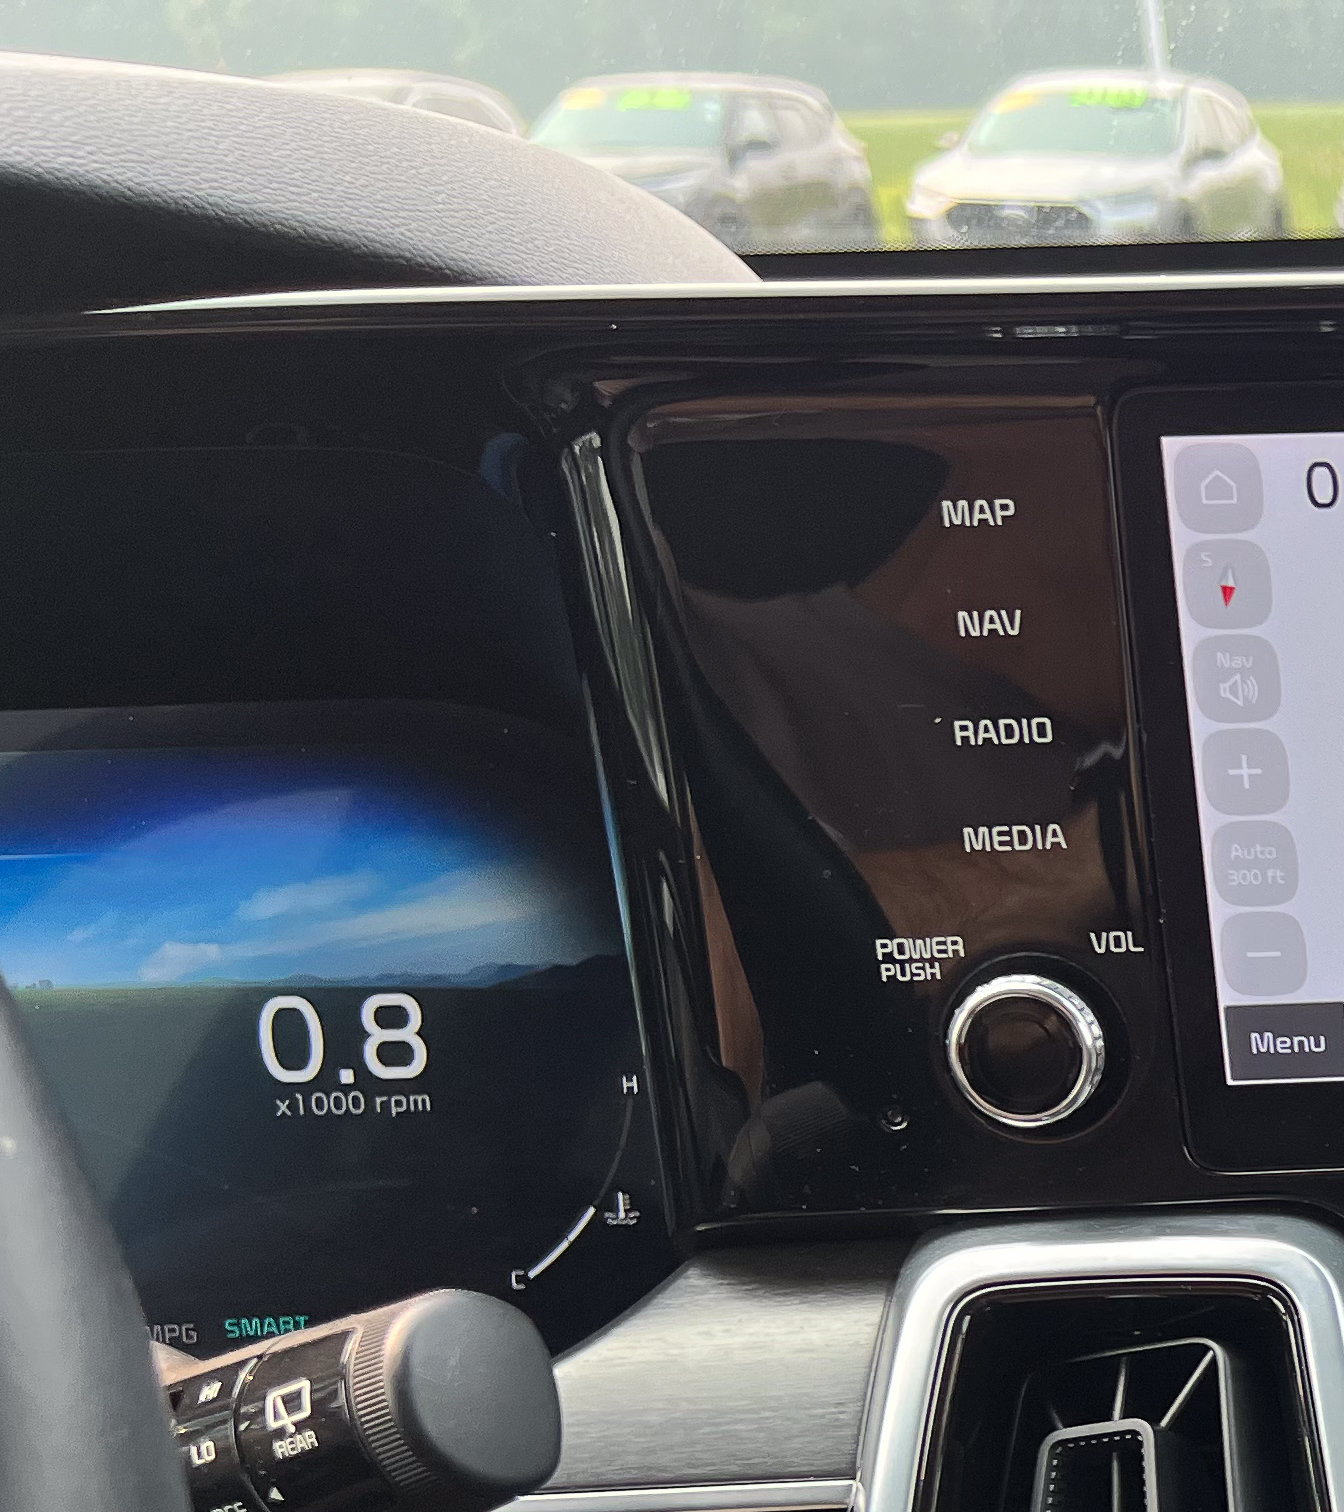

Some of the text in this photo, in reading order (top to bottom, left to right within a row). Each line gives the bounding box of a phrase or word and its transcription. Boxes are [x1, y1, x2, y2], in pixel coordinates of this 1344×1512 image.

[1306, 461, 1340, 509] 0
[941, 498, 1016, 528] MAP
[956, 609, 1022, 637] NAV
[1216, 651, 1253, 670] Nav
[953, 717, 1053, 746] RADIO
[962, 824, 1068, 853] MEDIA
[1230, 844, 1277, 860] Auto
[1228, 868, 1286, 886] 300 ft
[875, 936, 966, 962] POWER
[1089, 931, 1145, 954] VOL
[880, 962, 942, 983] PUSH
[257, 992, 429, 1084] 0.8
[1250, 1031, 1326, 1055] Menu
[621, 1074, 639, 1096] H
[275, 1090, 432, 1118] x1000 rpm
[224, 1315, 309, 1339] SMART
[190, 1440, 216, 1466] LO
[273, 1430, 319, 1460] REAR
